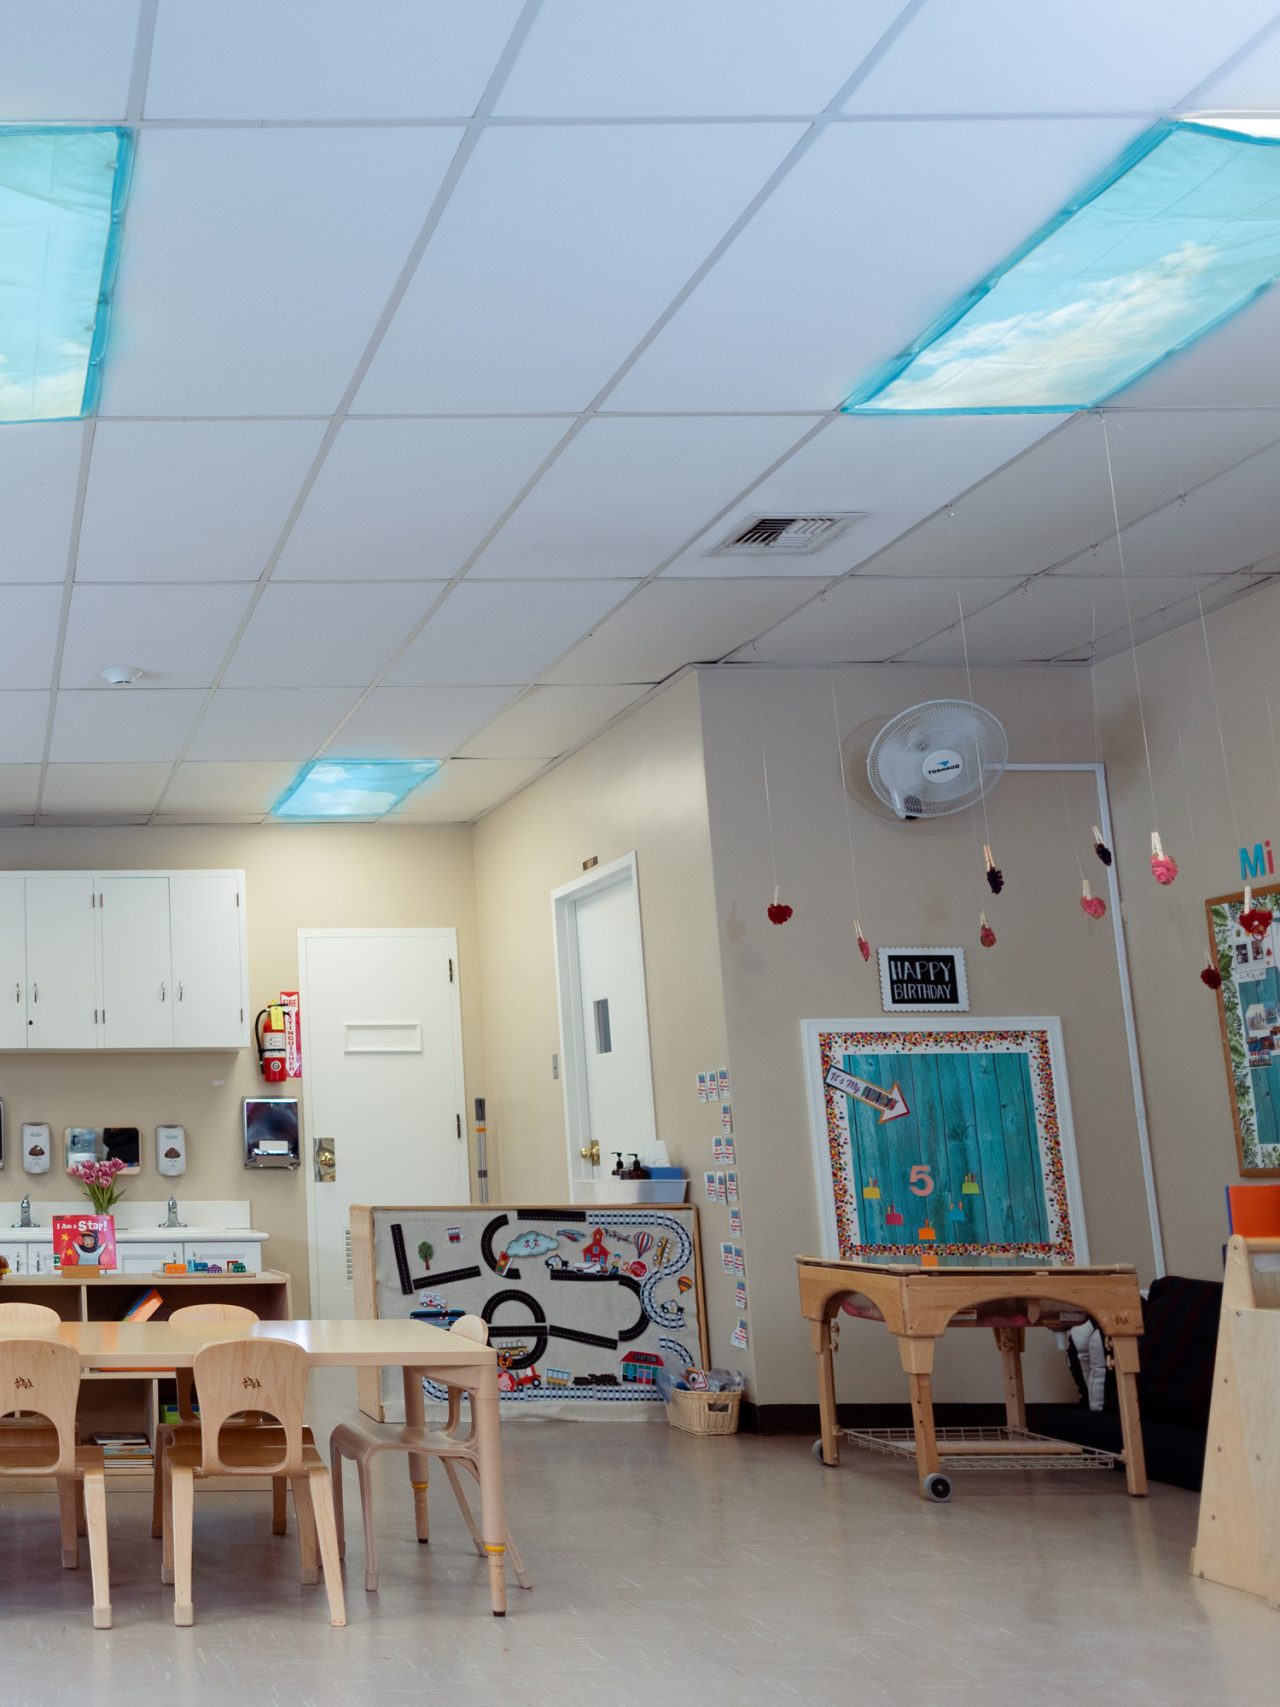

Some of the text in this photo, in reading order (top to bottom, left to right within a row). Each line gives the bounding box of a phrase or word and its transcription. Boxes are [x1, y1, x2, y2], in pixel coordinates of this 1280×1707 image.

[928, 763, 960, 775] TORNADO
[1238, 839, 1275, 881] Mi
[890, 960, 951, 982] HAPPY
[893, 982, 951, 1000] BIRTHDAY
[846, 1078, 861, 1094] My
[909, 1165, 934, 1197] 5
[78, 1220, 108, 1231] Star!
